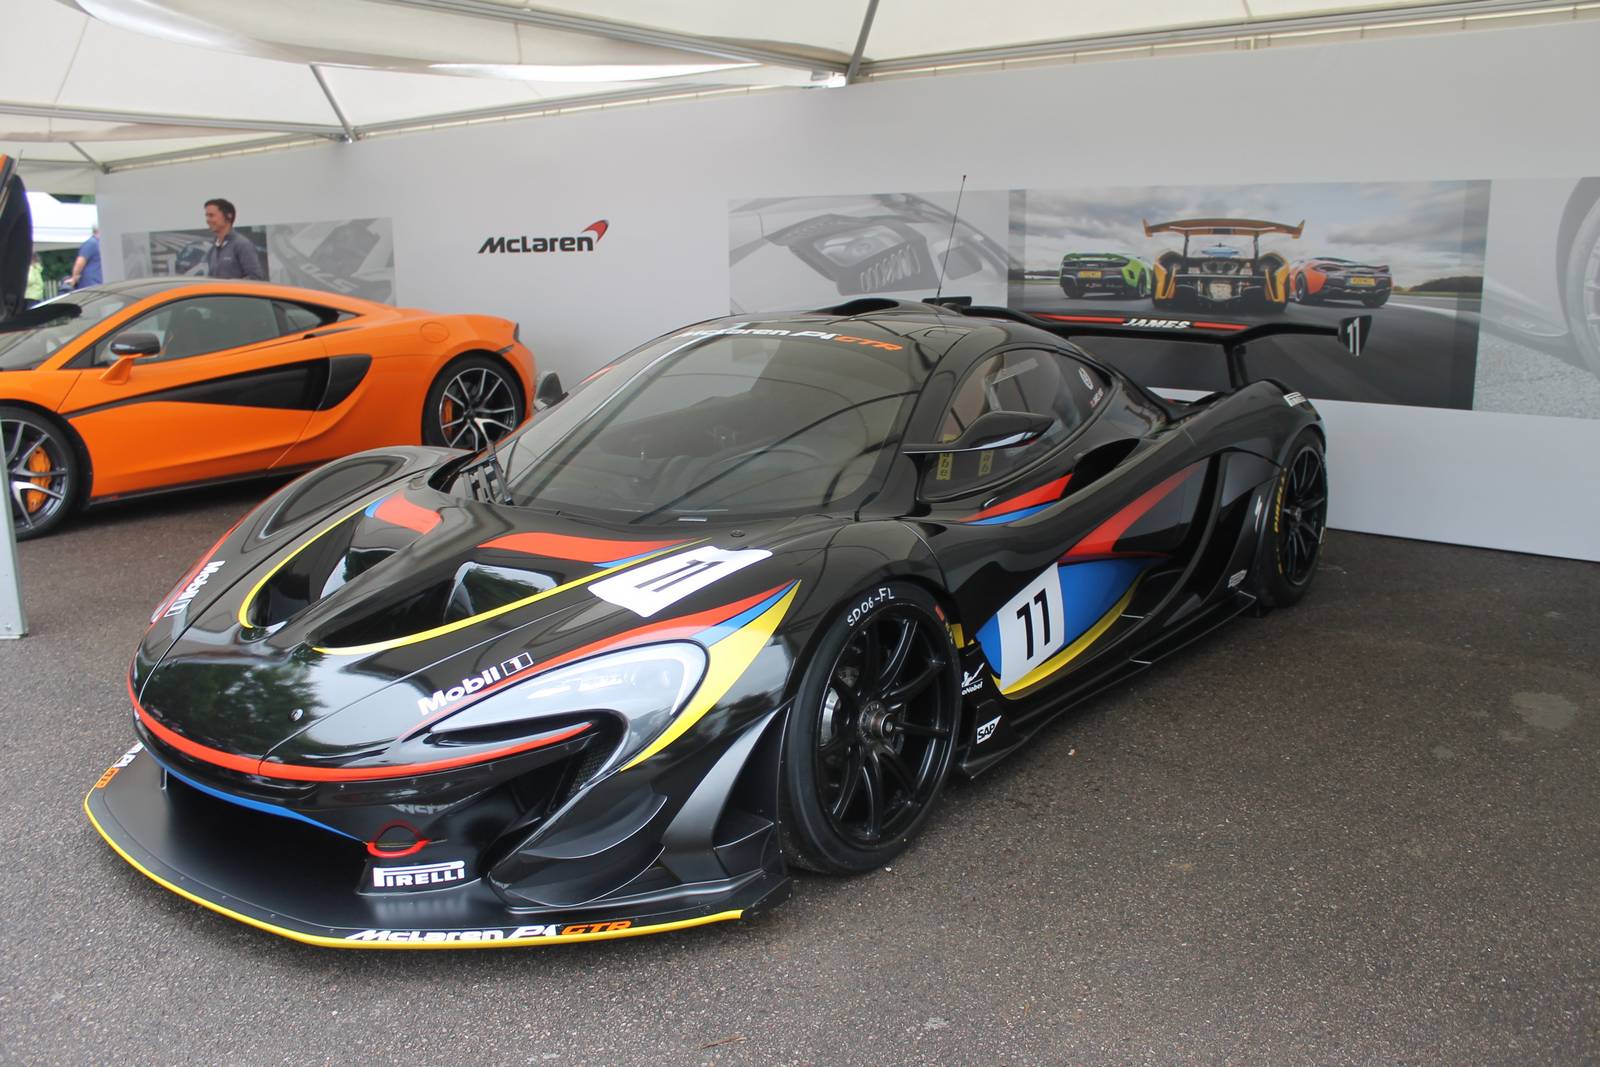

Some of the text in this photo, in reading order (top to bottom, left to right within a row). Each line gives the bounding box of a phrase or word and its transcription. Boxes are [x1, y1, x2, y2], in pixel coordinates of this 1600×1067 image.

[478, 235, 594, 254] McLaren
[1122, 317, 1191, 330] JAMES
[1346, 316, 1361, 357] 11
[833, 335, 903, 351] GTR
[177, 559, 226, 600] Mobil
[633, 558, 726, 593] 11
[846, 586, 896, 628] SD06-FL
[1016, 587, 1051, 661] 11
[416, 666, 502, 717] Mobil
[977, 722, 997, 742] SAP
[372, 859, 466, 888] PIRELLI
[344, 920, 632, 942] McLaren P1 GTR
